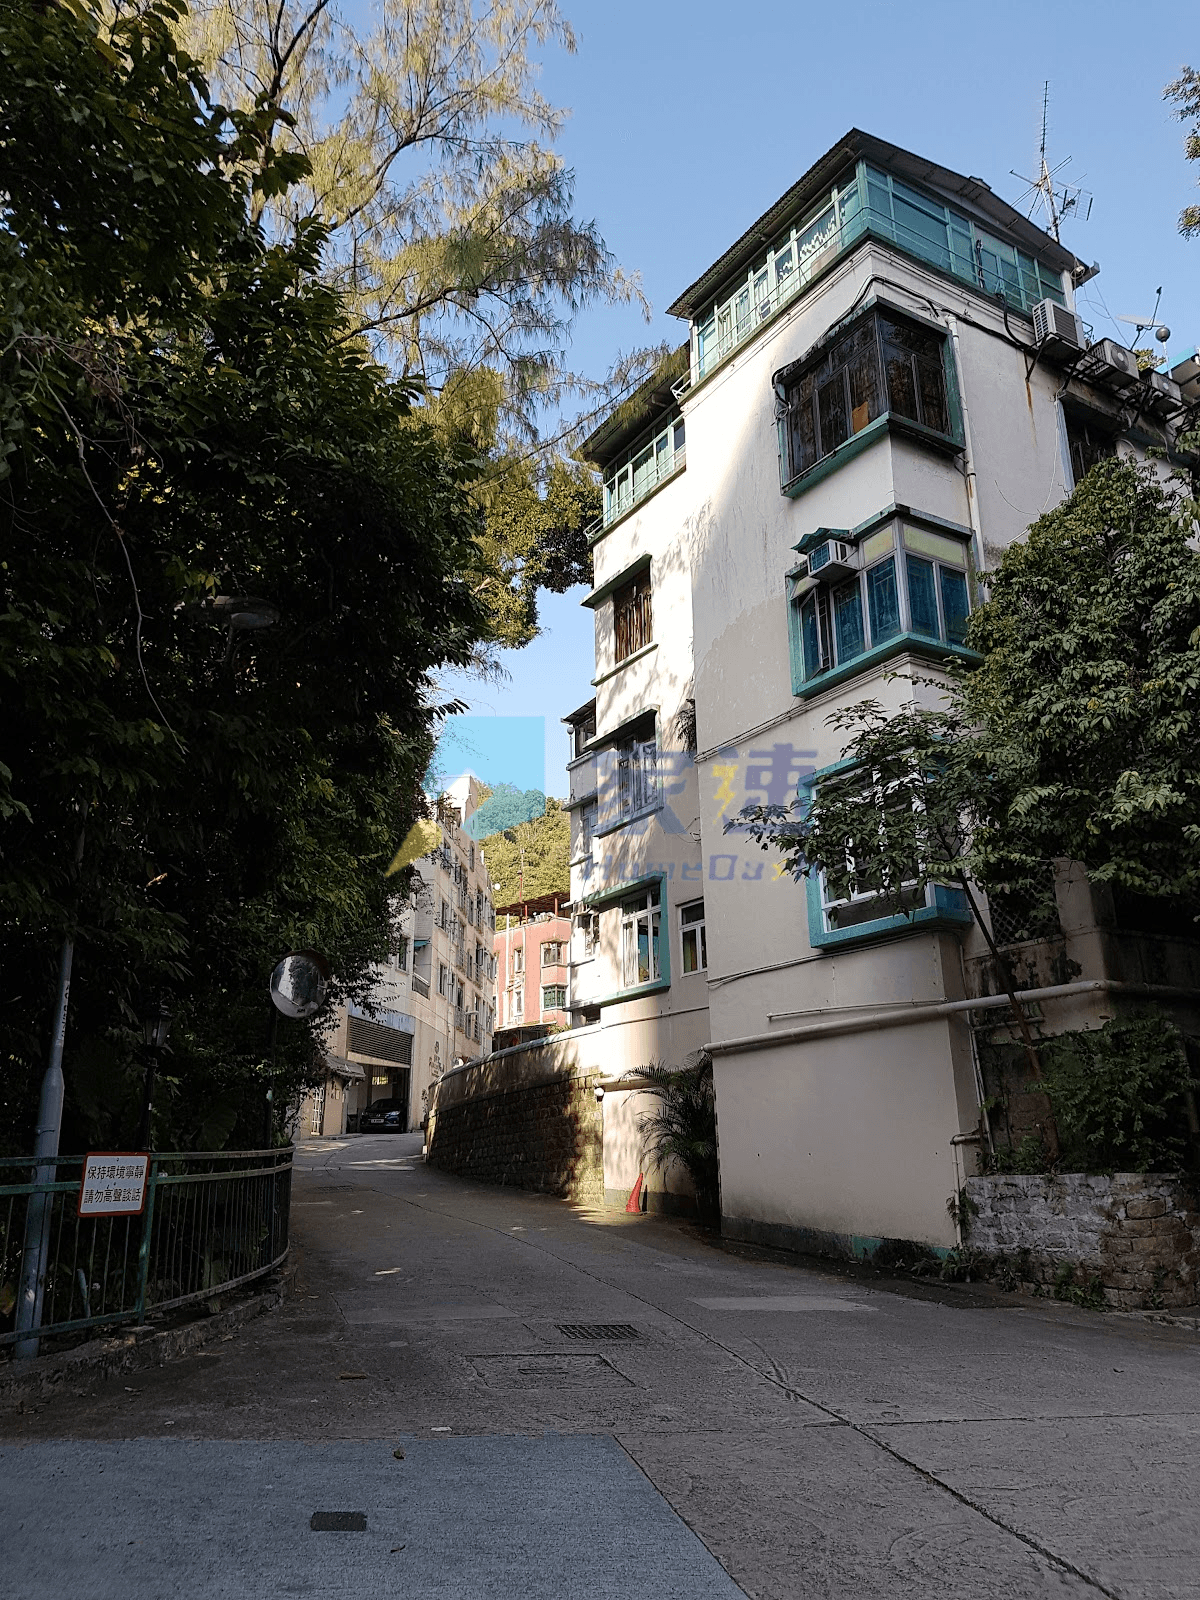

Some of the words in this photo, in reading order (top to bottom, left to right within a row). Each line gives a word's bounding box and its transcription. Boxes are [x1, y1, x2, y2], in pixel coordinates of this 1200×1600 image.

[87, 1165, 144, 1179] 保持環境寧靜
[83, 1187, 141, 1204] 請勿高聲談話
